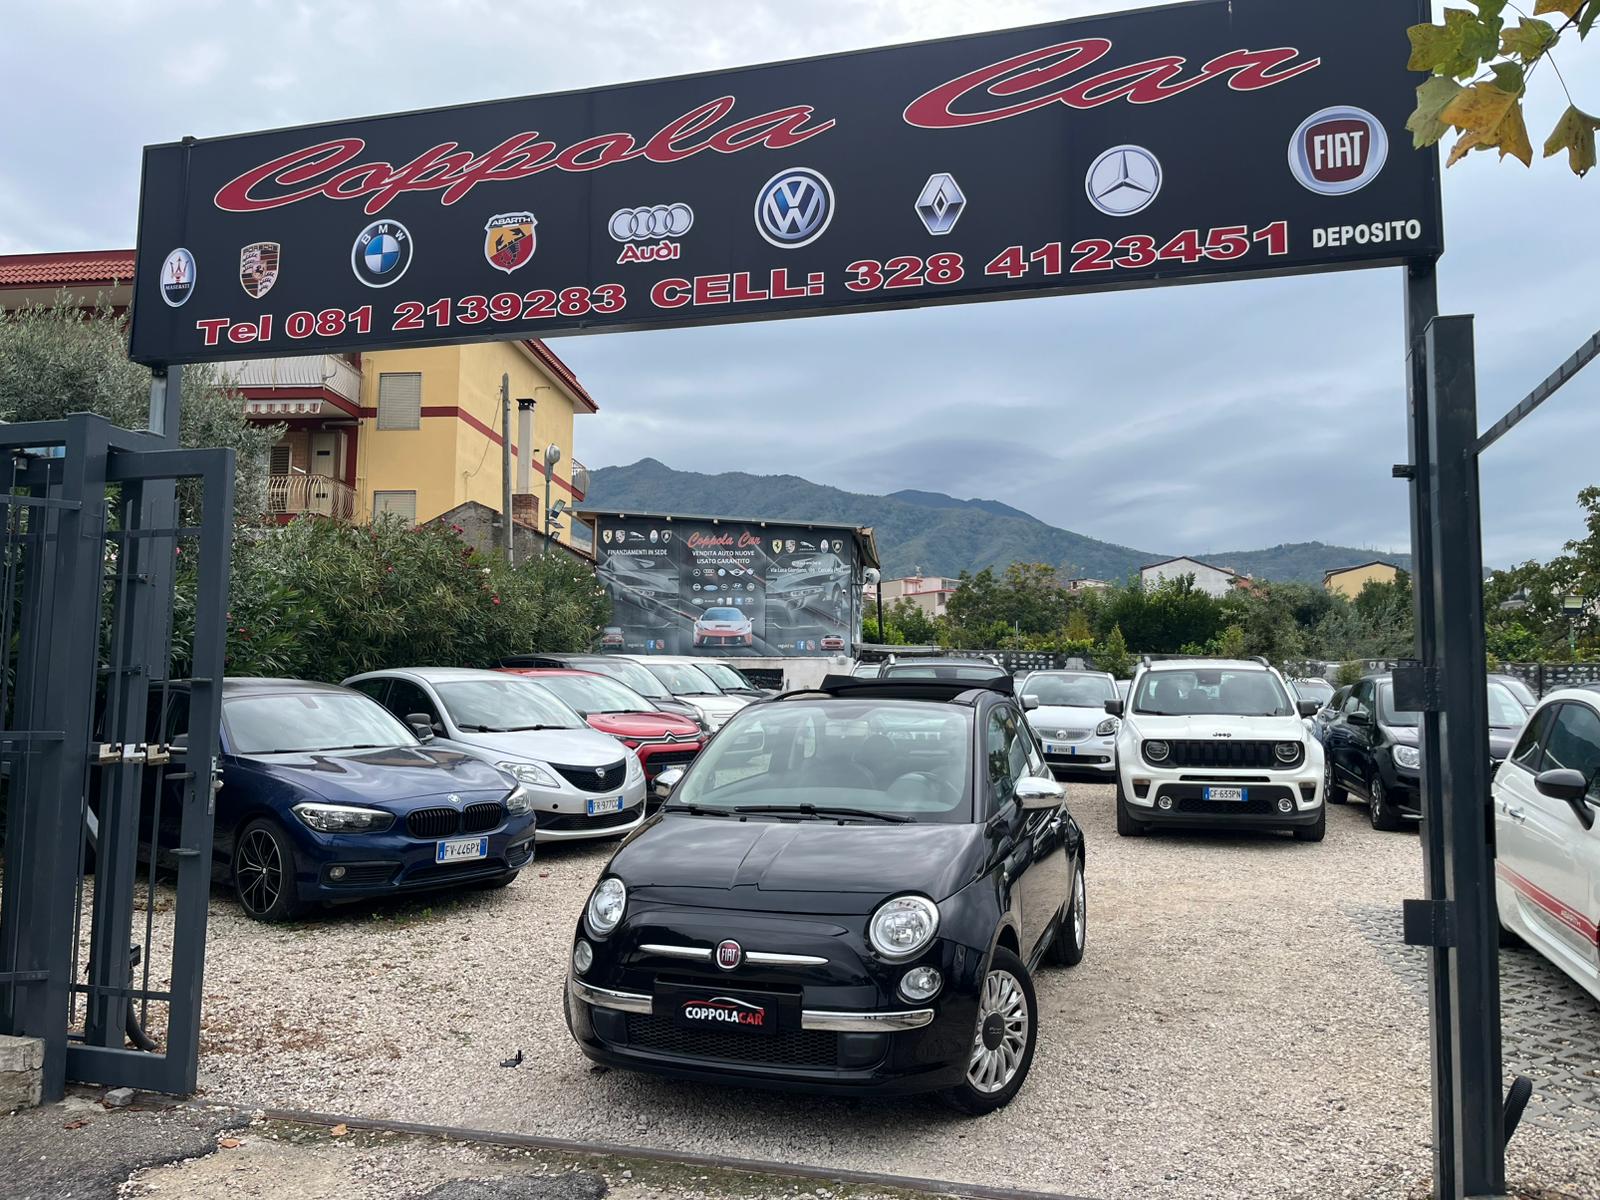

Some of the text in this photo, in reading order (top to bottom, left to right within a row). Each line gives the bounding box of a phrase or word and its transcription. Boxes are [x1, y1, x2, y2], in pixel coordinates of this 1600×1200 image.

[214, 37, 1320, 215] Coppola Car
[1313, 130, 1364, 171] FIAT
[491, 216, 531, 226] ABARTH
[1312, 219, 1421, 248] DEPOSITO
[616, 240, 680, 264] Audi
[196, 221, 1288, 345] Tel 081 2139283 CELL: 328 4123451
[687, 531, 761, 549] Coppola Car
[721, 948, 737, 962] FIAT
